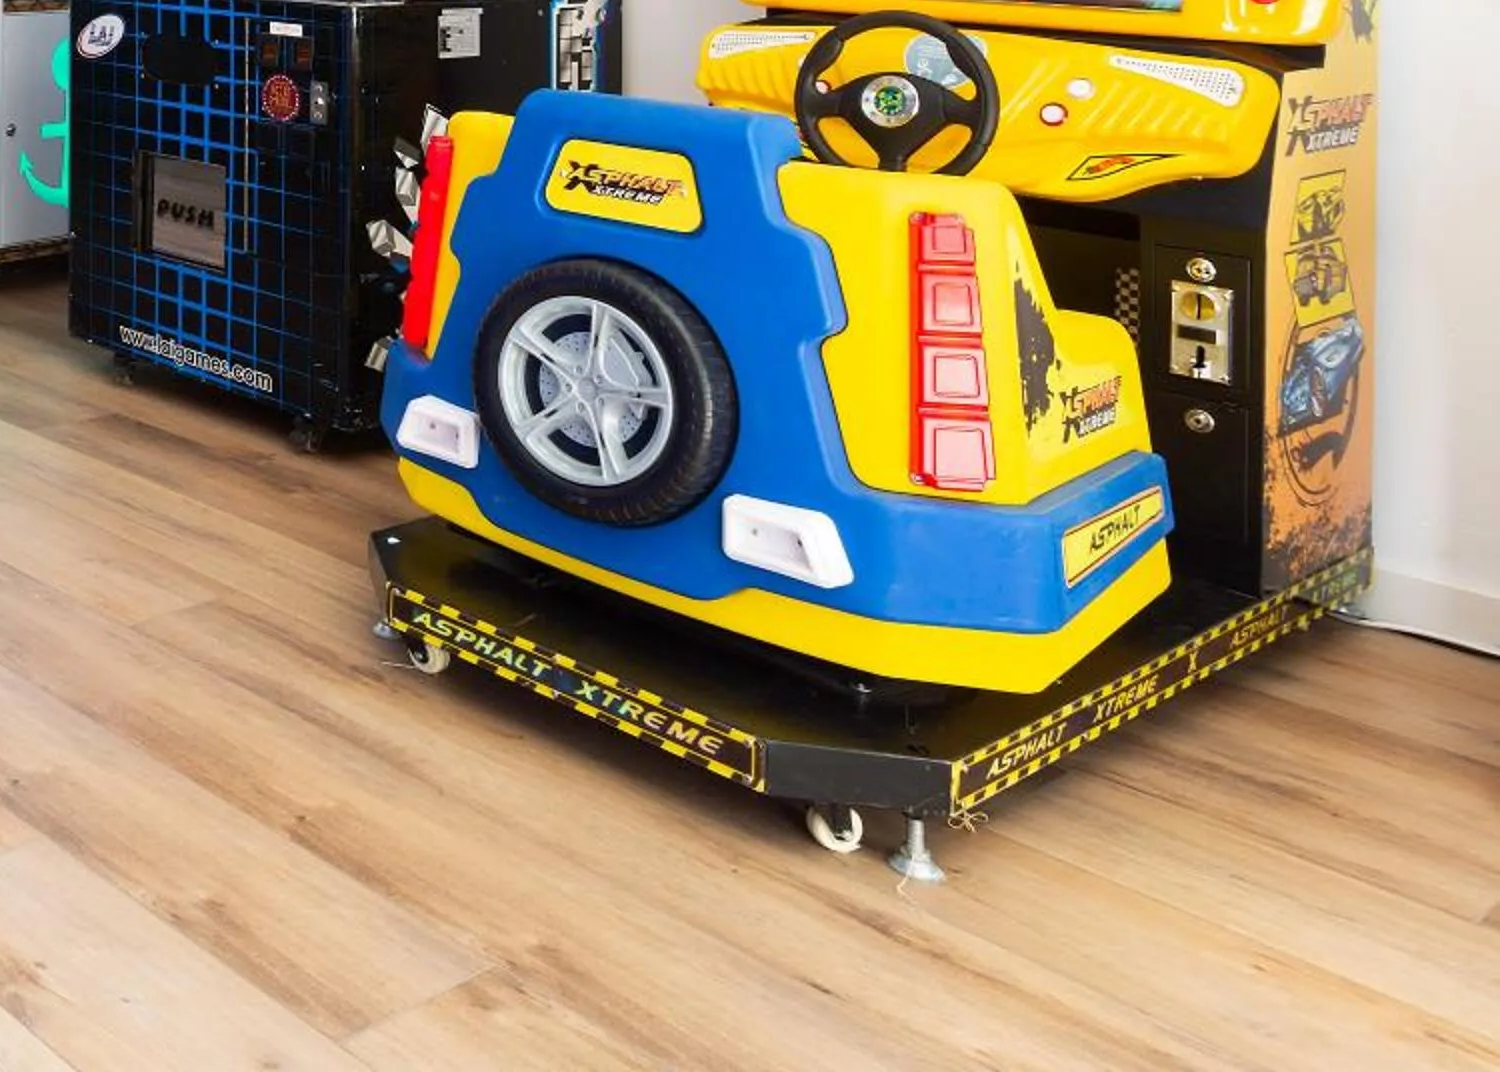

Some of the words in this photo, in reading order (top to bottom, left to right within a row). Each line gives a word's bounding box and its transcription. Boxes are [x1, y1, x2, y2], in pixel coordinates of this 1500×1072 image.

[157, 198, 215, 227] PUSH
[119, 325, 273, 393] www.laigames.com
[1089, 504, 1141, 555] ASPHALT
[412, 611, 552, 678] ASPHALT
[574, 679, 724, 755] XTREME
[986, 722, 1068, 779] ASPHALT
[1092, 676, 1159, 724] XTREME
[1229, 605, 1289, 648] ASPHALT
